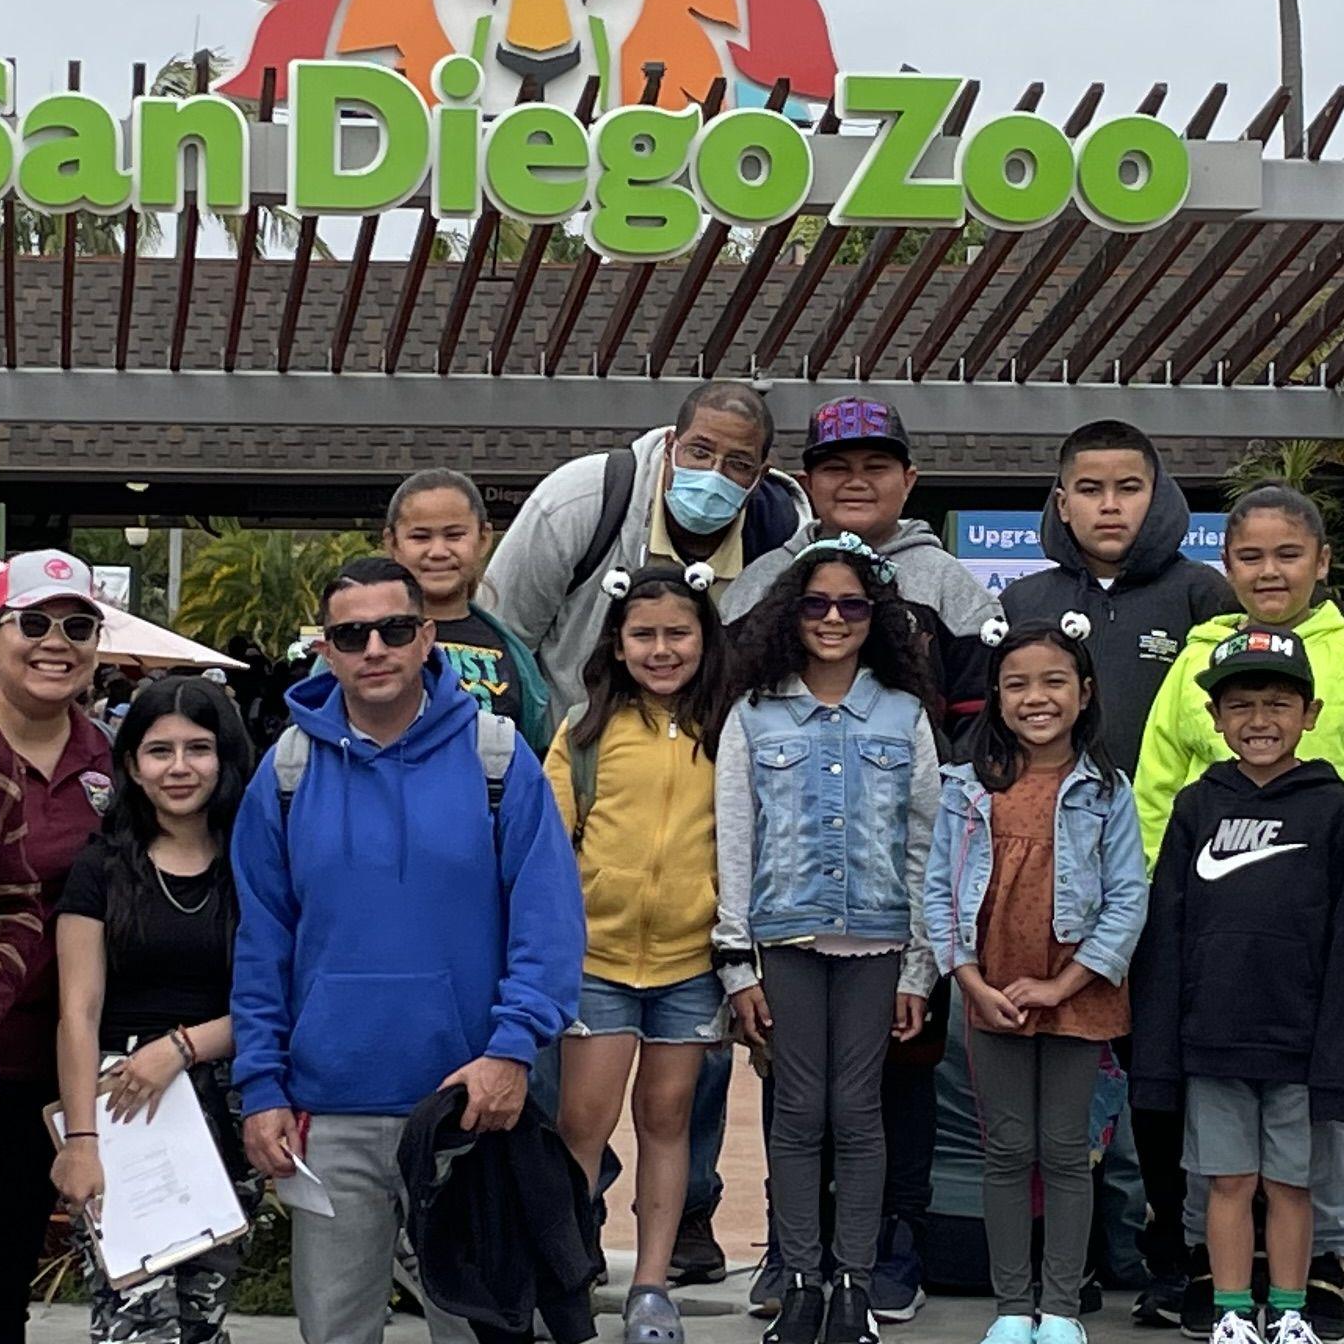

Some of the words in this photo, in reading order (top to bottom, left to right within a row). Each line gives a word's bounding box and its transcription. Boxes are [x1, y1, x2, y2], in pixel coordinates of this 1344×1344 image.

[287, 52, 814, 260] Diego
[833, 72, 1191, 233] Zoo
[485, 487, 529, 505] Dieg
[1212, 818, 1283, 851] NIKE
